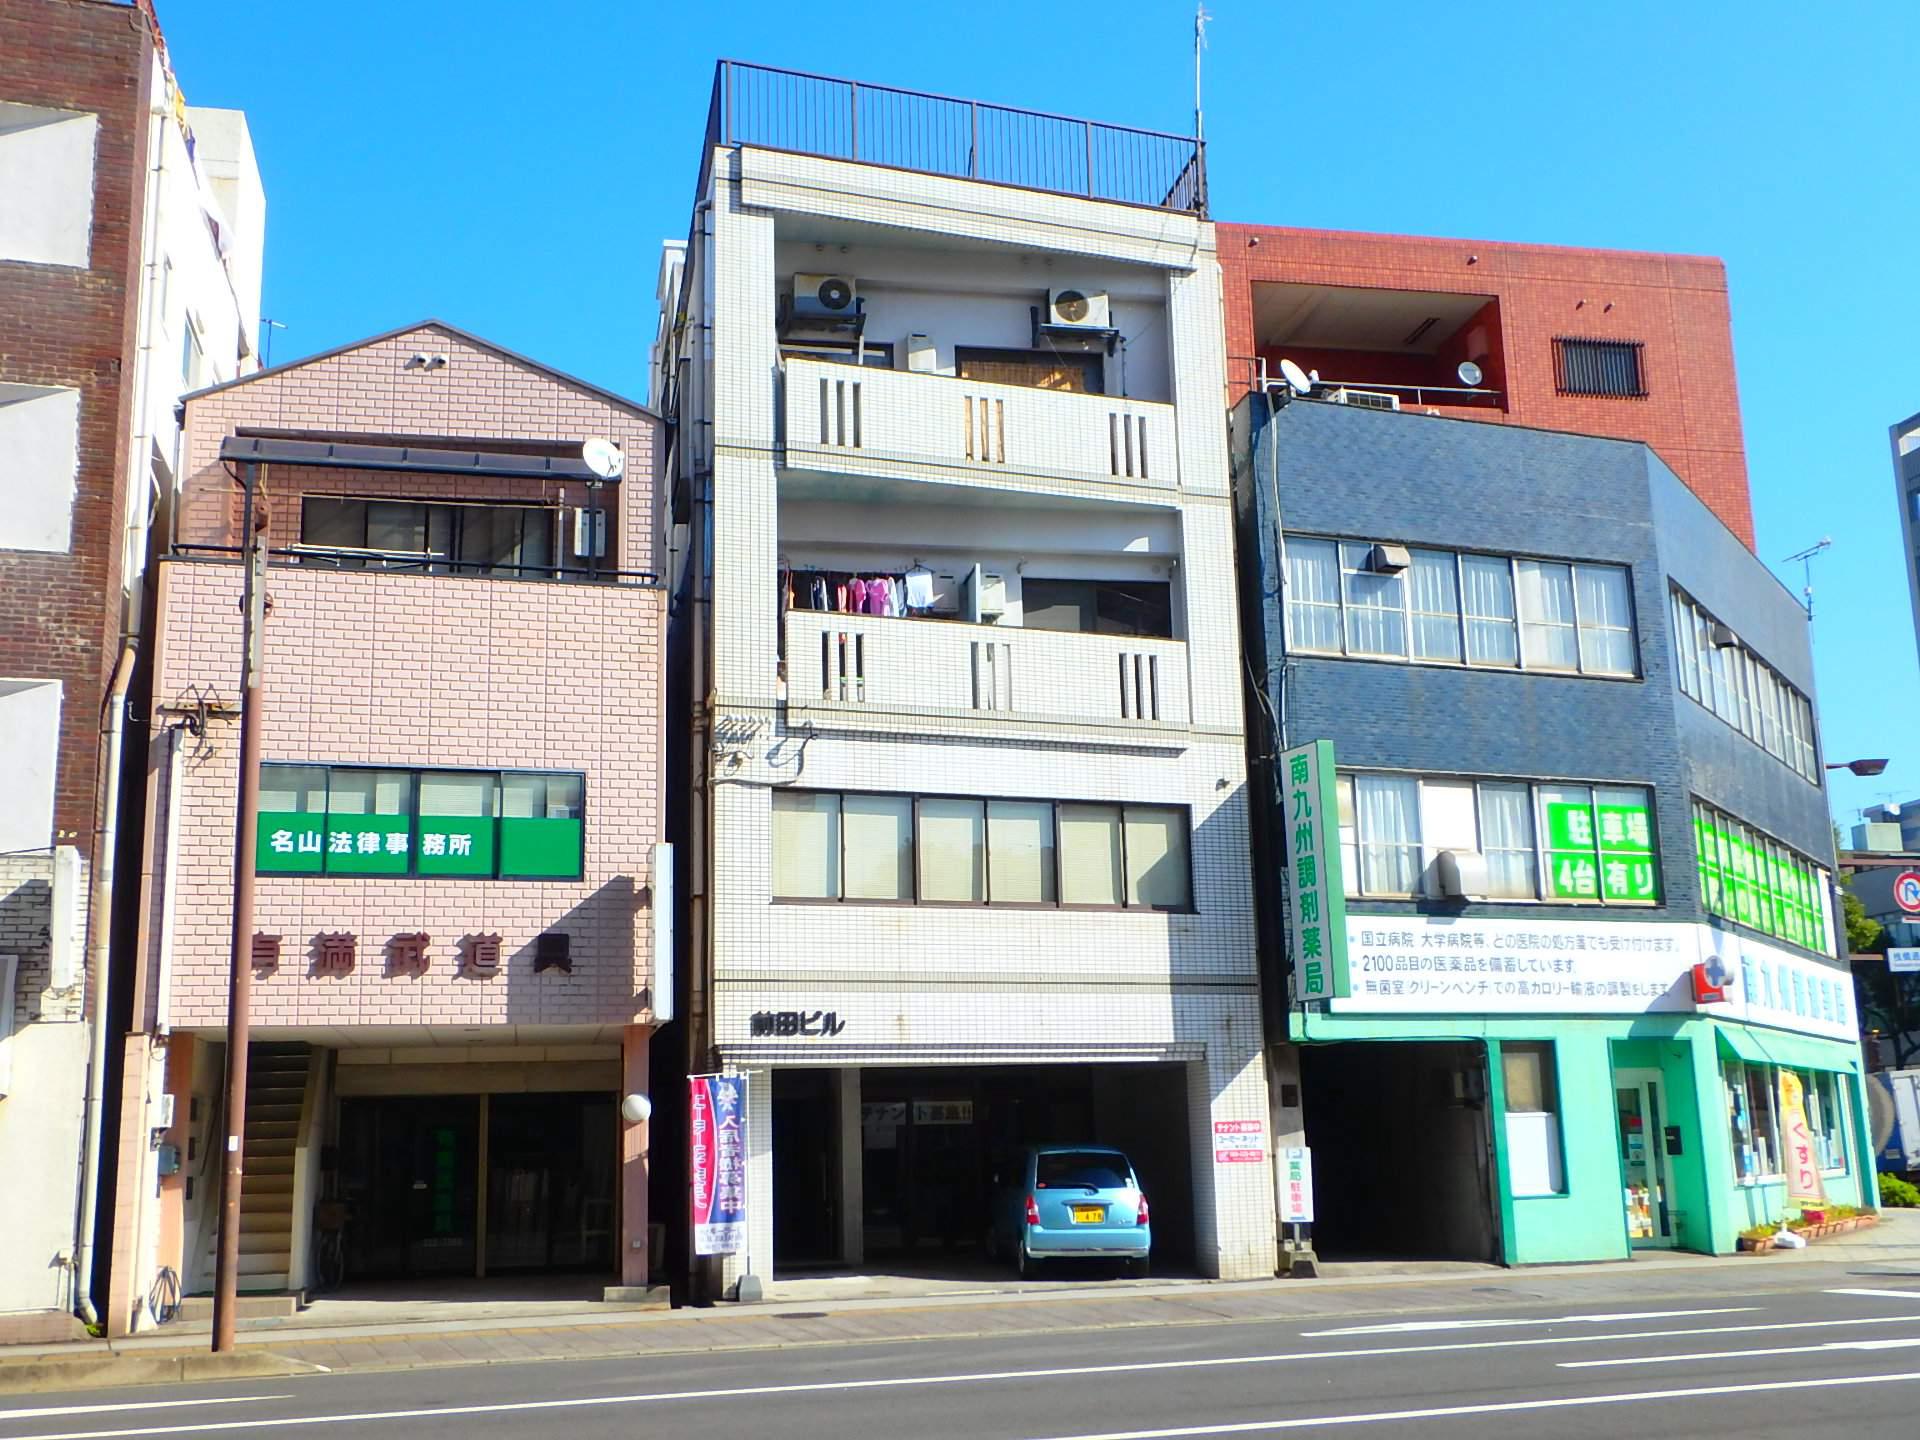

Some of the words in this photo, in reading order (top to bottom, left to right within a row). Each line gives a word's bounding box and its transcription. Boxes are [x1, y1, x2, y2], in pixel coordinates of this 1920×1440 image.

[270, 829, 472, 856] 名山法律事務所
[1567, 809, 1649, 849] 駐車場
[1290, 753, 1324, 995] 南九州調剤薬局
[1558, 859, 1654, 896] 4台有り
[749, 1010, 846, 1037] 前田ビル
[1792, 1122, 1814, 1190] くすり
